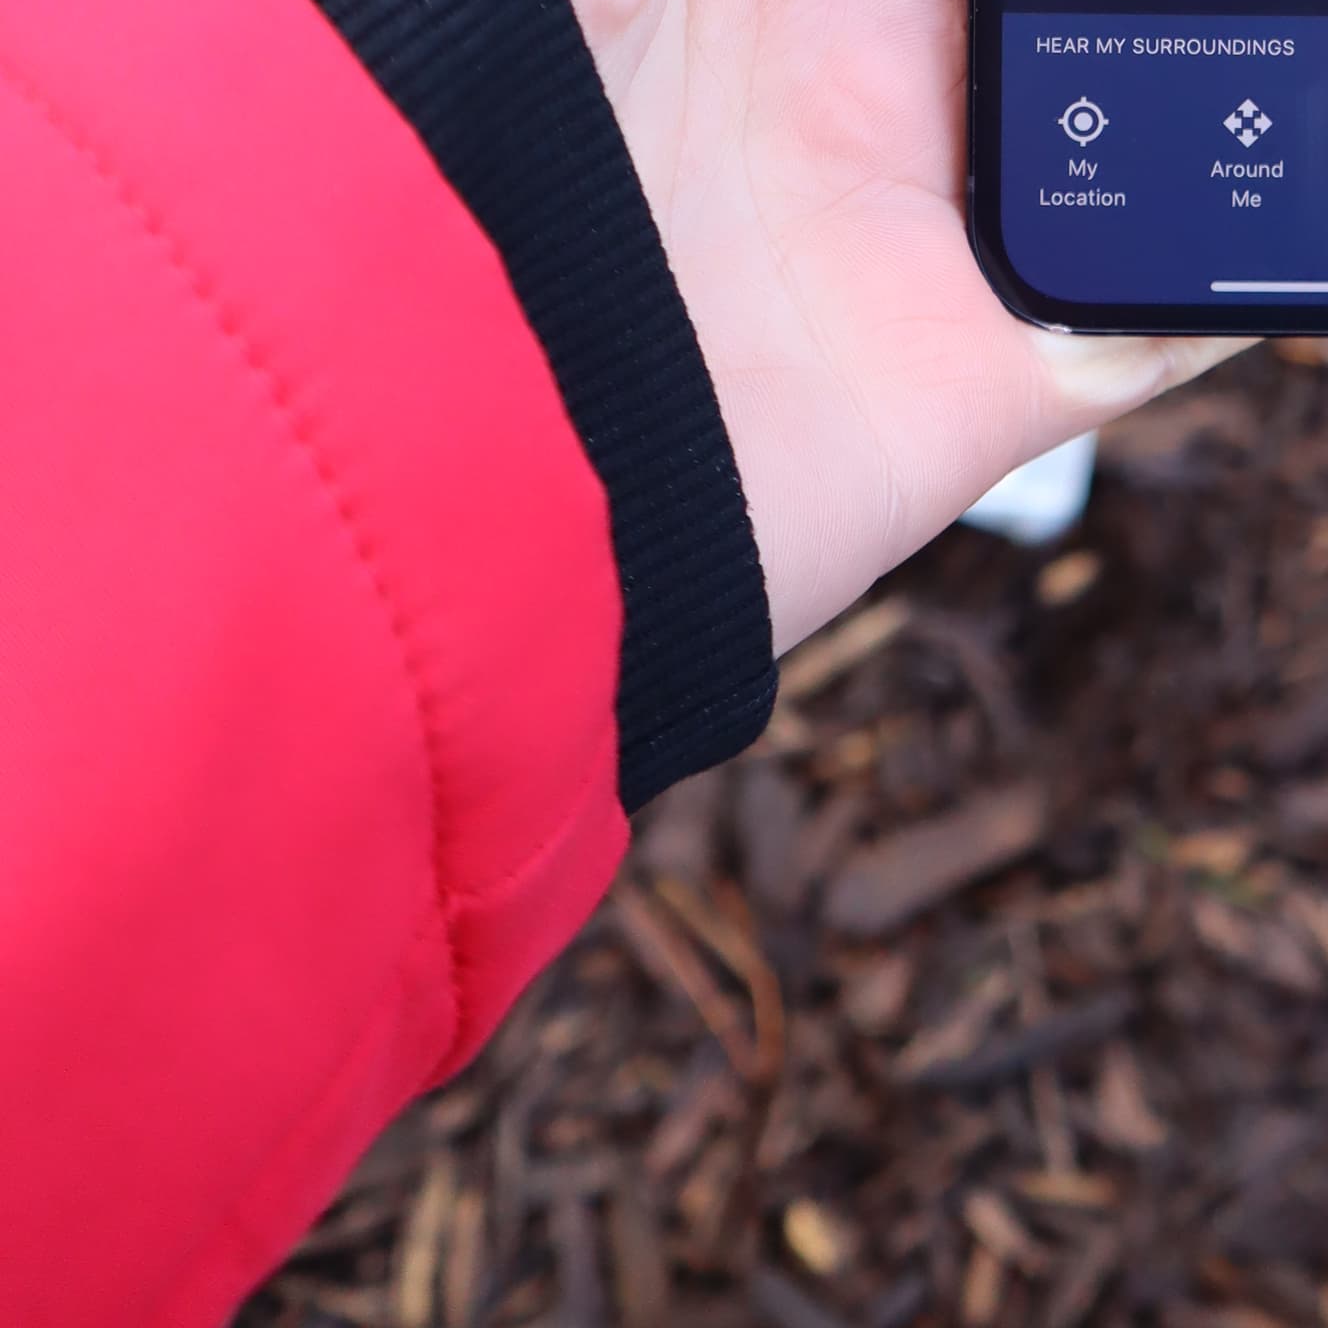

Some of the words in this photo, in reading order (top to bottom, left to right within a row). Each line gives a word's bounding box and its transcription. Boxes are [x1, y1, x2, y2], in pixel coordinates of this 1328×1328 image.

[1036, 37, 1089, 54] HEAR
[1096, 38, 1126, 54] MY
[1132, 38, 1295, 56] SURROUNDINGS
[1068, 159, 1098, 180] My
[1210, 160, 1284, 178] Around
[1039, 188, 1126, 207] Location
[1231, 190, 1262, 208] Me
